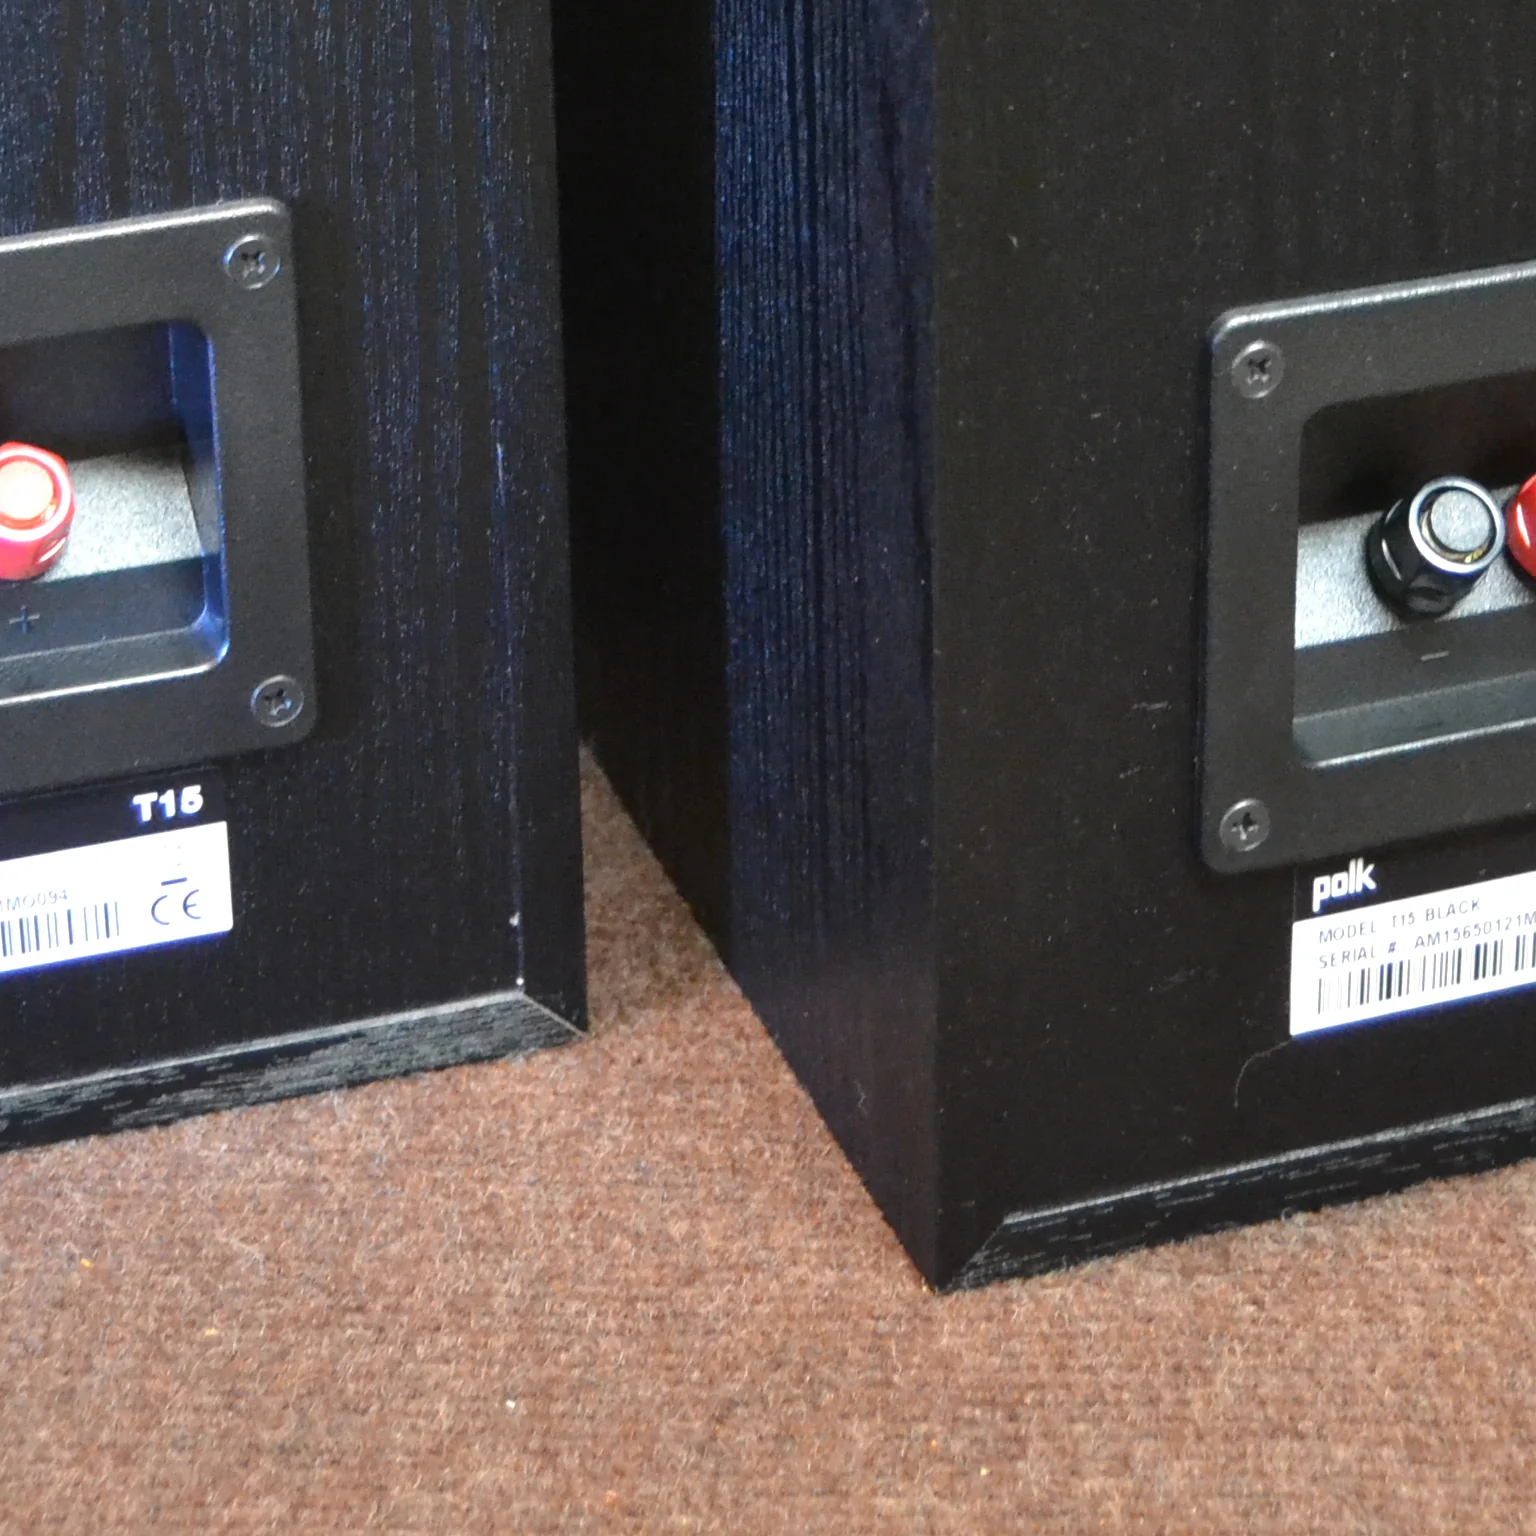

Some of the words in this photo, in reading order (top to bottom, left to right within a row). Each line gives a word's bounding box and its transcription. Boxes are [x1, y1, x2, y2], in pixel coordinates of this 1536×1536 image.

[132, 784, 204, 822] T15
[1312, 857, 1377, 913] polk
[1319, 920, 1377, 945] MODEL
[1392, 911, 1416, 929] T15
[1424, 897, 1481, 922] BLACK
[1318, 944, 1376, 970] SERIAL
